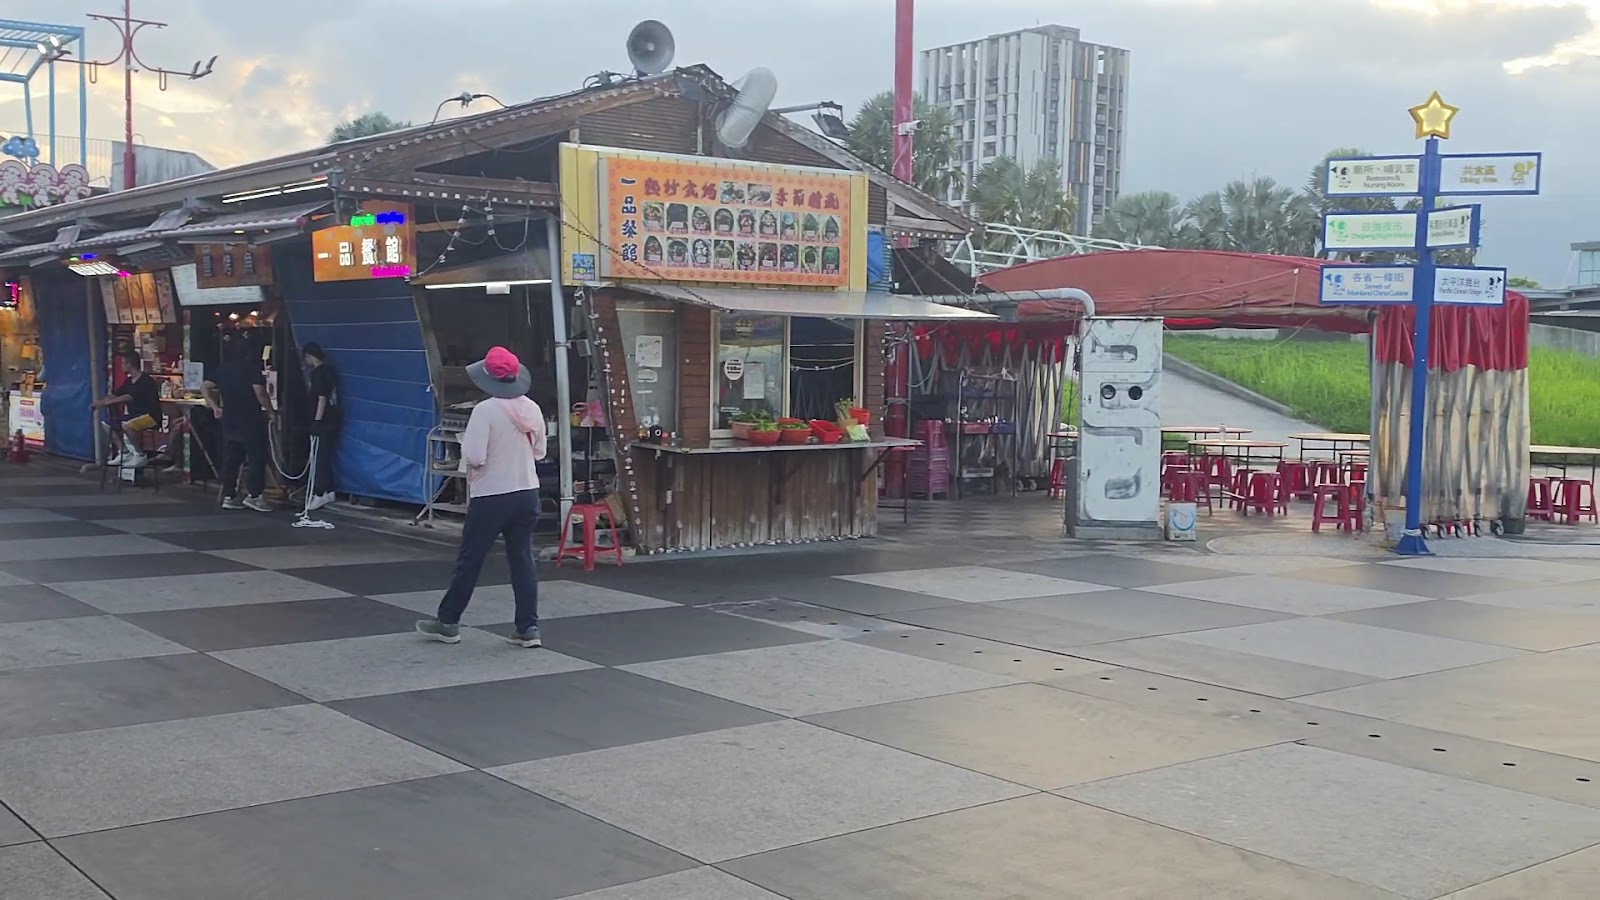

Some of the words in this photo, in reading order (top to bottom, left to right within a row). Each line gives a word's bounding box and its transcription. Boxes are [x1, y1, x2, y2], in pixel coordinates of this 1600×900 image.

[317, 236, 402, 267] 一品餐館
[1352, 272, 1405, 283] 各省一條街
[1441, 276, 1481, 288] 太平洋舞台
[1468, 288, 1482, 297] Stage
